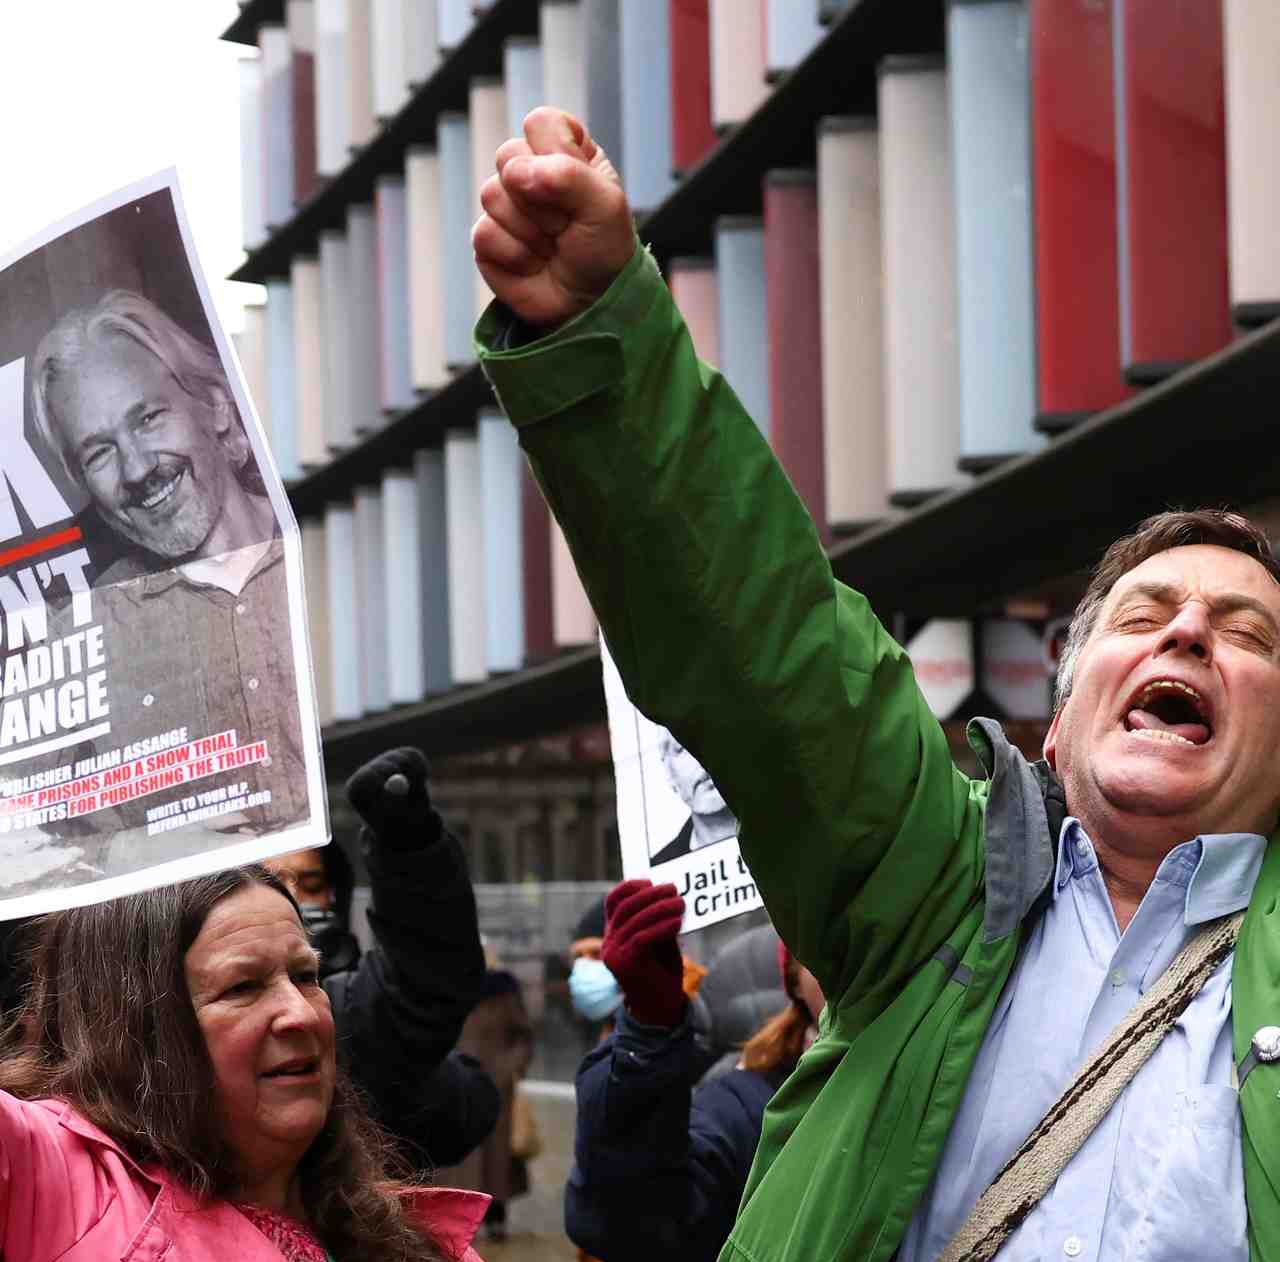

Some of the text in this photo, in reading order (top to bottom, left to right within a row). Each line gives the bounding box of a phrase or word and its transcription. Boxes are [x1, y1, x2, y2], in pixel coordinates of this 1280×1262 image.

[38, 776, 100, 805] PRISONS
[104, 764, 130, 787] AND
[135, 761, 144, 777] A
[147, 746, 190, 772] SHOW
[195, 733, 234, 756] TRIAL
[74, 749, 121, 778] JULIAN
[123, 727, 187, 762] ASSANGE
[14, 802, 67, 829] STATES
[70, 796, 96, 816] FOR
[100, 767, 183, 804] PUBLISHING
[188, 759, 212, 779] THE
[218, 743, 265, 768] TRUTH
[147, 801, 181, 821] WRITE
[182, 796, 196, 811] TO
[197, 788, 226, 806] YOUR
[680, 859, 728, 896] Jail
[695, 883, 756, 916] Crim
